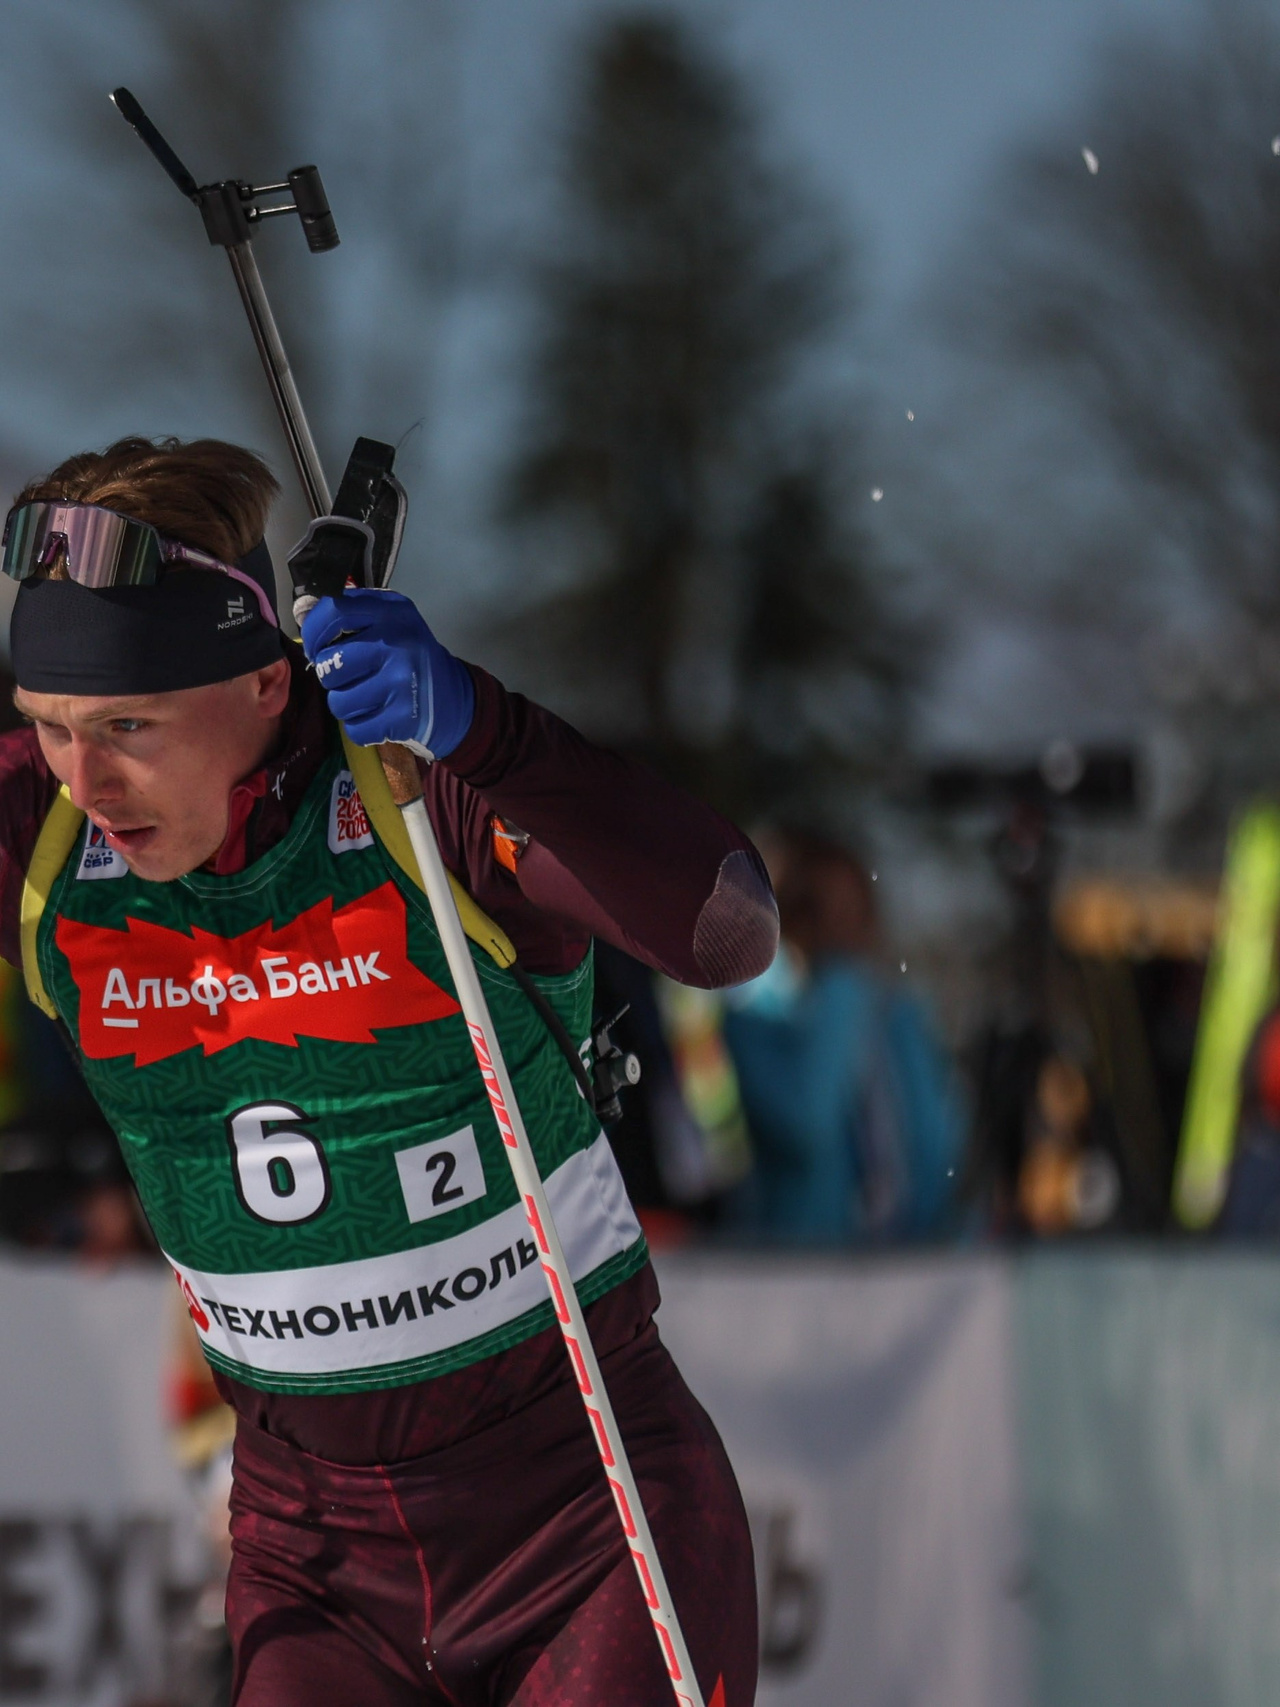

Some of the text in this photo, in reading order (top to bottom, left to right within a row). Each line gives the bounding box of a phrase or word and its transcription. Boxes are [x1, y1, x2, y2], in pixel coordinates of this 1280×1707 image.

[337, 812, 371, 842] 2026
[101, 951, 392, 1017] Альфа Банк
[224, 1099, 332, 1228] 6
[425, 1151, 465, 1207] 2
[201, 1237, 539, 1340] ТЕХНОНИКОЛЬ
